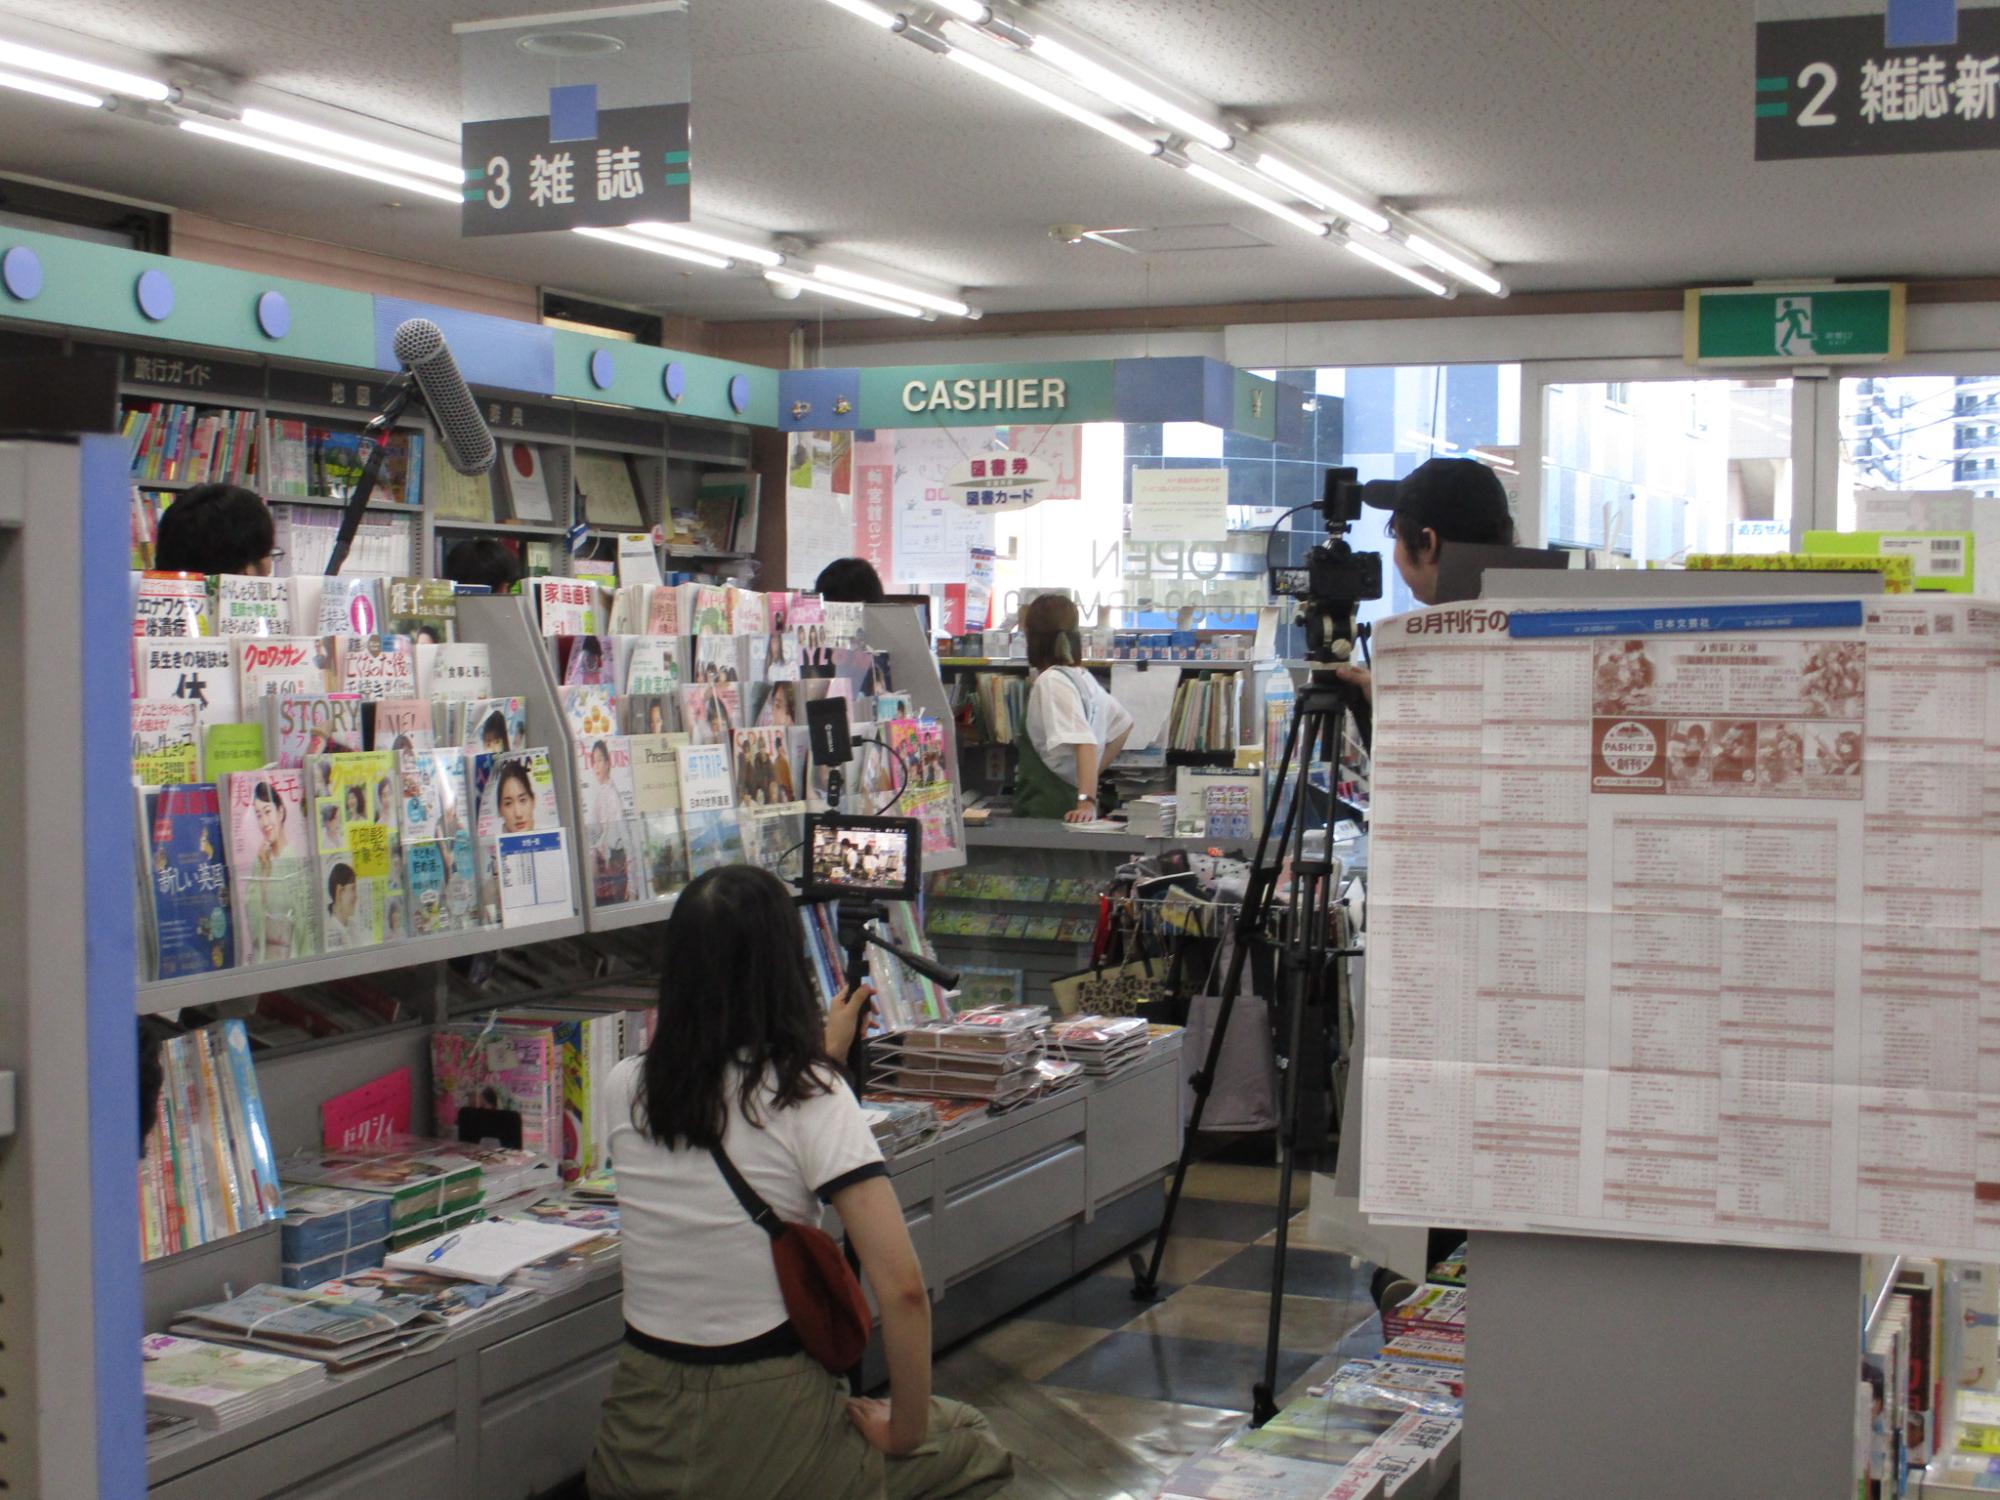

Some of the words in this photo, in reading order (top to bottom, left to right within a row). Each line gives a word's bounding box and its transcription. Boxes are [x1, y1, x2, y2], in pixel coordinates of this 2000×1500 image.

[1796, 61, 1838, 127] 2
[487, 156, 512, 209] 3
[529, 146, 644, 207] 雑誌
[133, 357, 210, 385] 旅行ガイド
[902, 377, 1066, 413] CASHIER
[970, 458, 1029, 478] 図書券
[966, 489, 1034, 505] 図書カード
[150, 651, 229, 669] 長生きの秘訣は
[244, 644, 306, 672] クロワッサン
[281, 700, 363, 736] STORY
